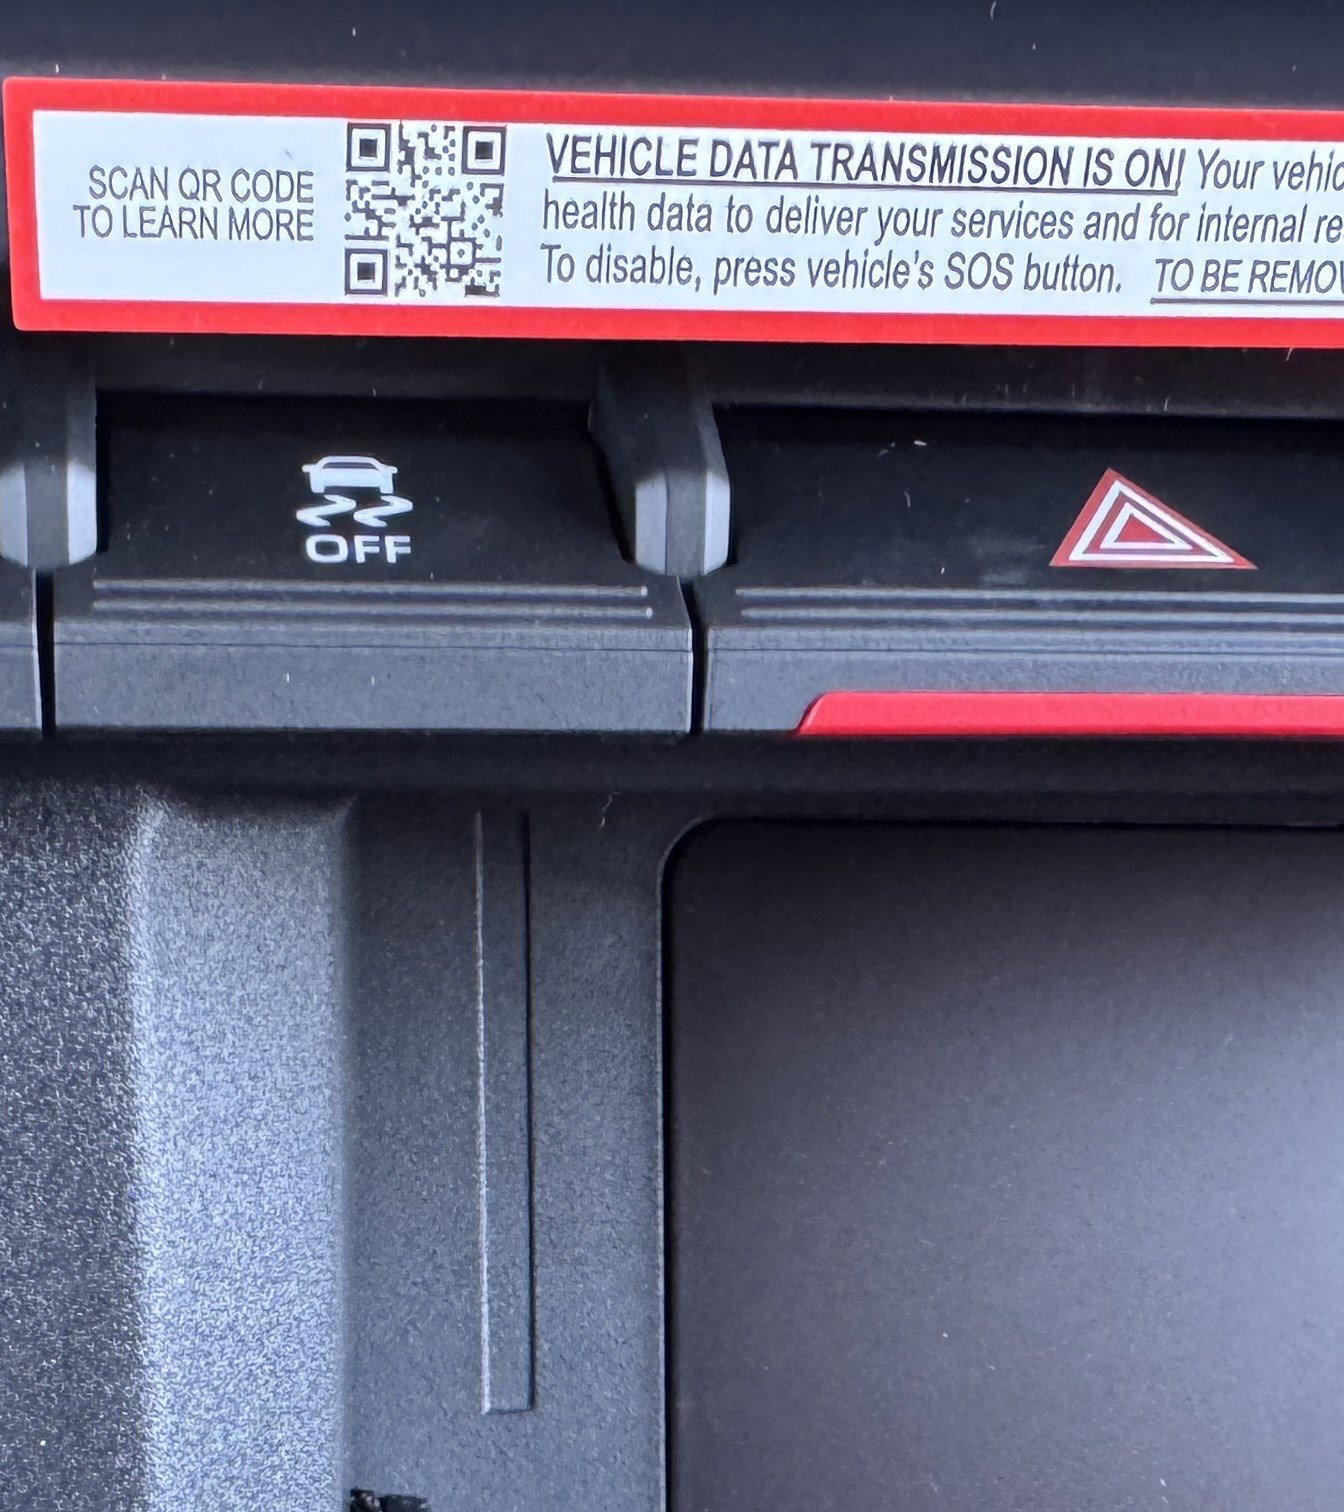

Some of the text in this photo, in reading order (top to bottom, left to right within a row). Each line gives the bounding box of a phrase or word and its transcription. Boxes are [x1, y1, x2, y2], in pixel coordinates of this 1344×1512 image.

[546, 132, 699, 177] VEHICLE
[710, 139, 798, 180] DATA
[811, 141, 1074, 187] TRANSMISSION
[1084, 147, 1114, 186] IS
[1125, 148, 1186, 189] ON!
[1198, 148, 1264, 189] Your
[88, 165, 314, 204] SCAN QR CODE
[73, 205, 314, 241] TO LEARN MORE
[542, 188, 635, 231] health
[647, 192, 713, 232] data
[726, 194, 752, 233] to
[766, 194, 868, 236] deliver
[874, 207, 943, 246] your
[951, 201, 1074, 239] services
[1084, 202, 1141, 241] and
[1149, 202, 1190, 242] for
[1196, 201, 1307, 242] internal
[540, 243, 1122, 296] To disable, press vehicle's SOS button.
[1155, 258, 1194, 293] TO
[1200, 259, 1244, 292] BE
[304, 534, 412, 564] OFF
